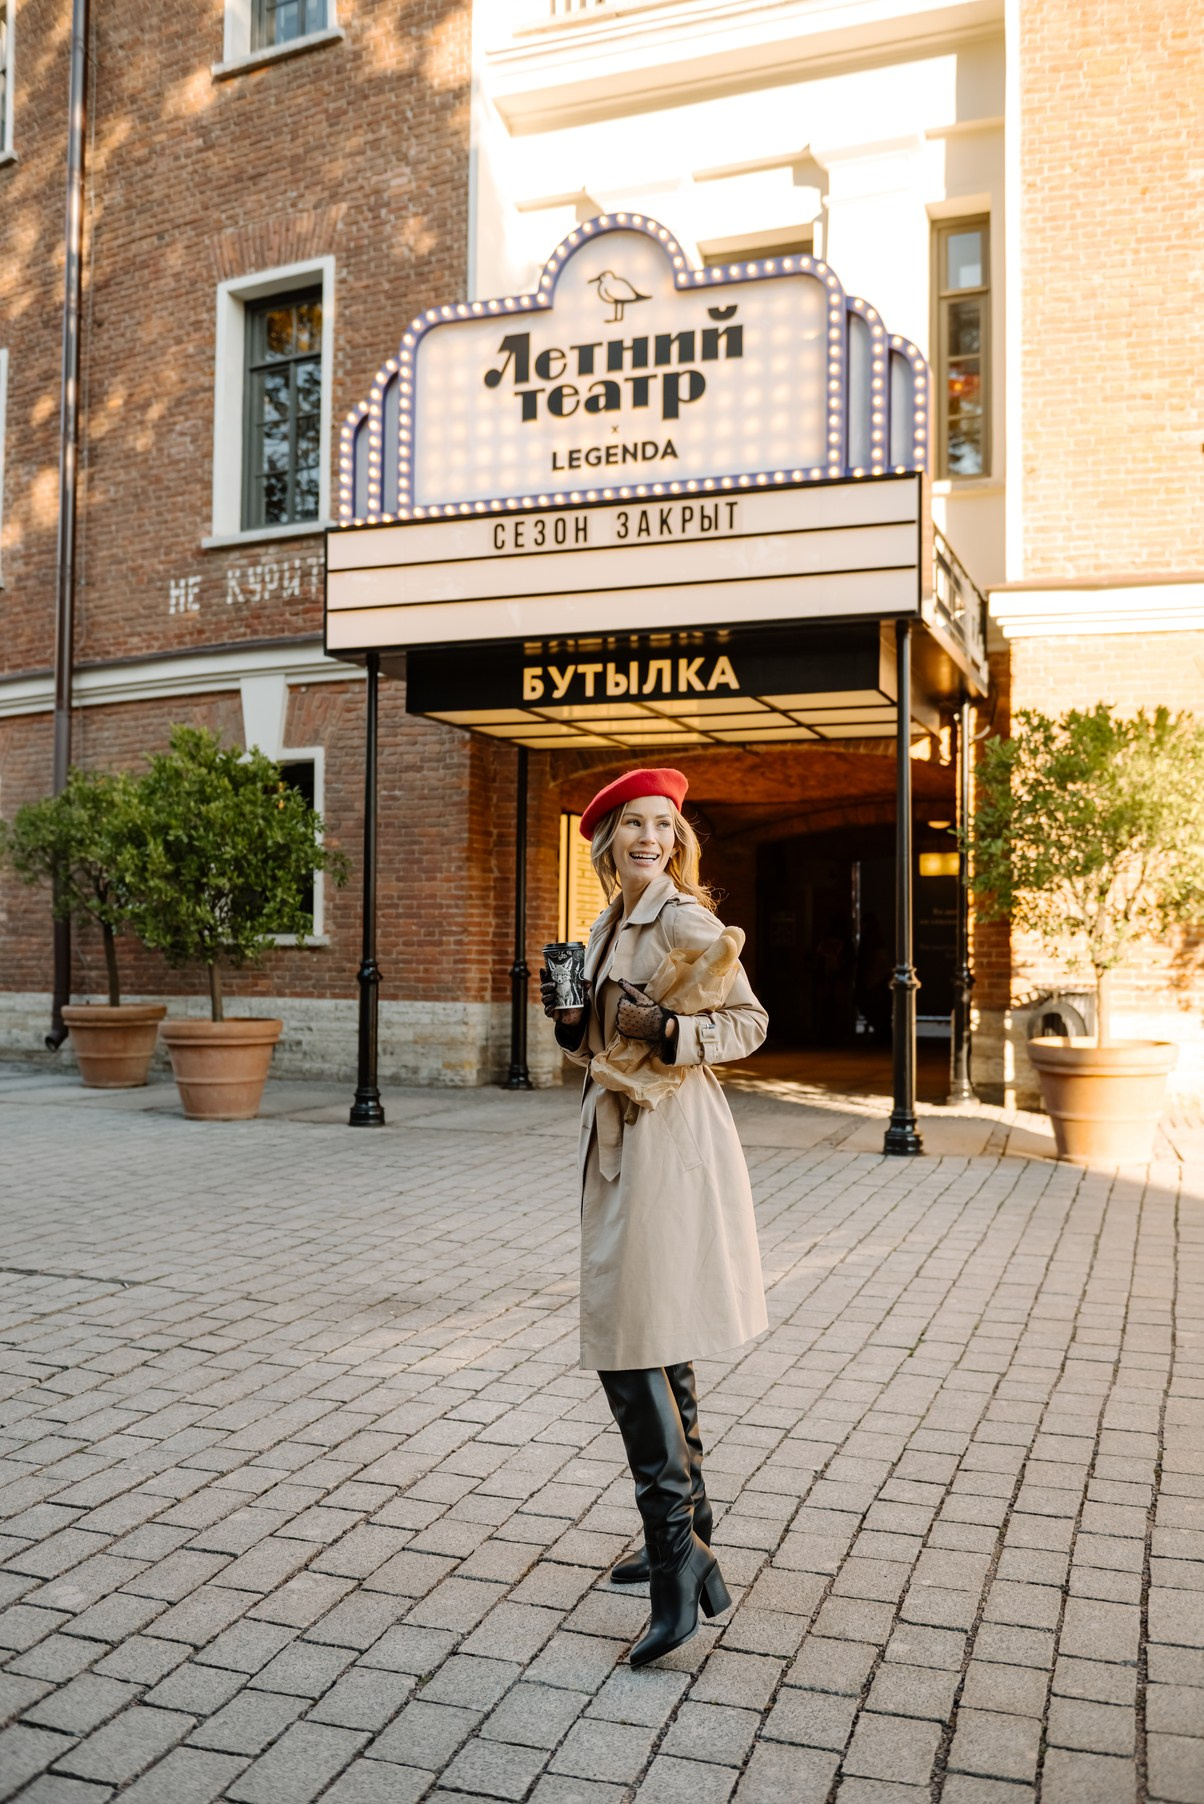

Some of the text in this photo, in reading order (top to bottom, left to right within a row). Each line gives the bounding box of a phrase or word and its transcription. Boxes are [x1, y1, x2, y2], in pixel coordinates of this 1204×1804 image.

[484, 305, 744, 388] Летний
[514, 370, 706, 423] театр
[552, 439, 679, 472] LEGENDA
[493, 502, 738, 550] СЕЗОН ЗАКРЫТ
[169, 575, 202, 615] НЕ
[523, 655, 740, 701] БУТЫЛКА
